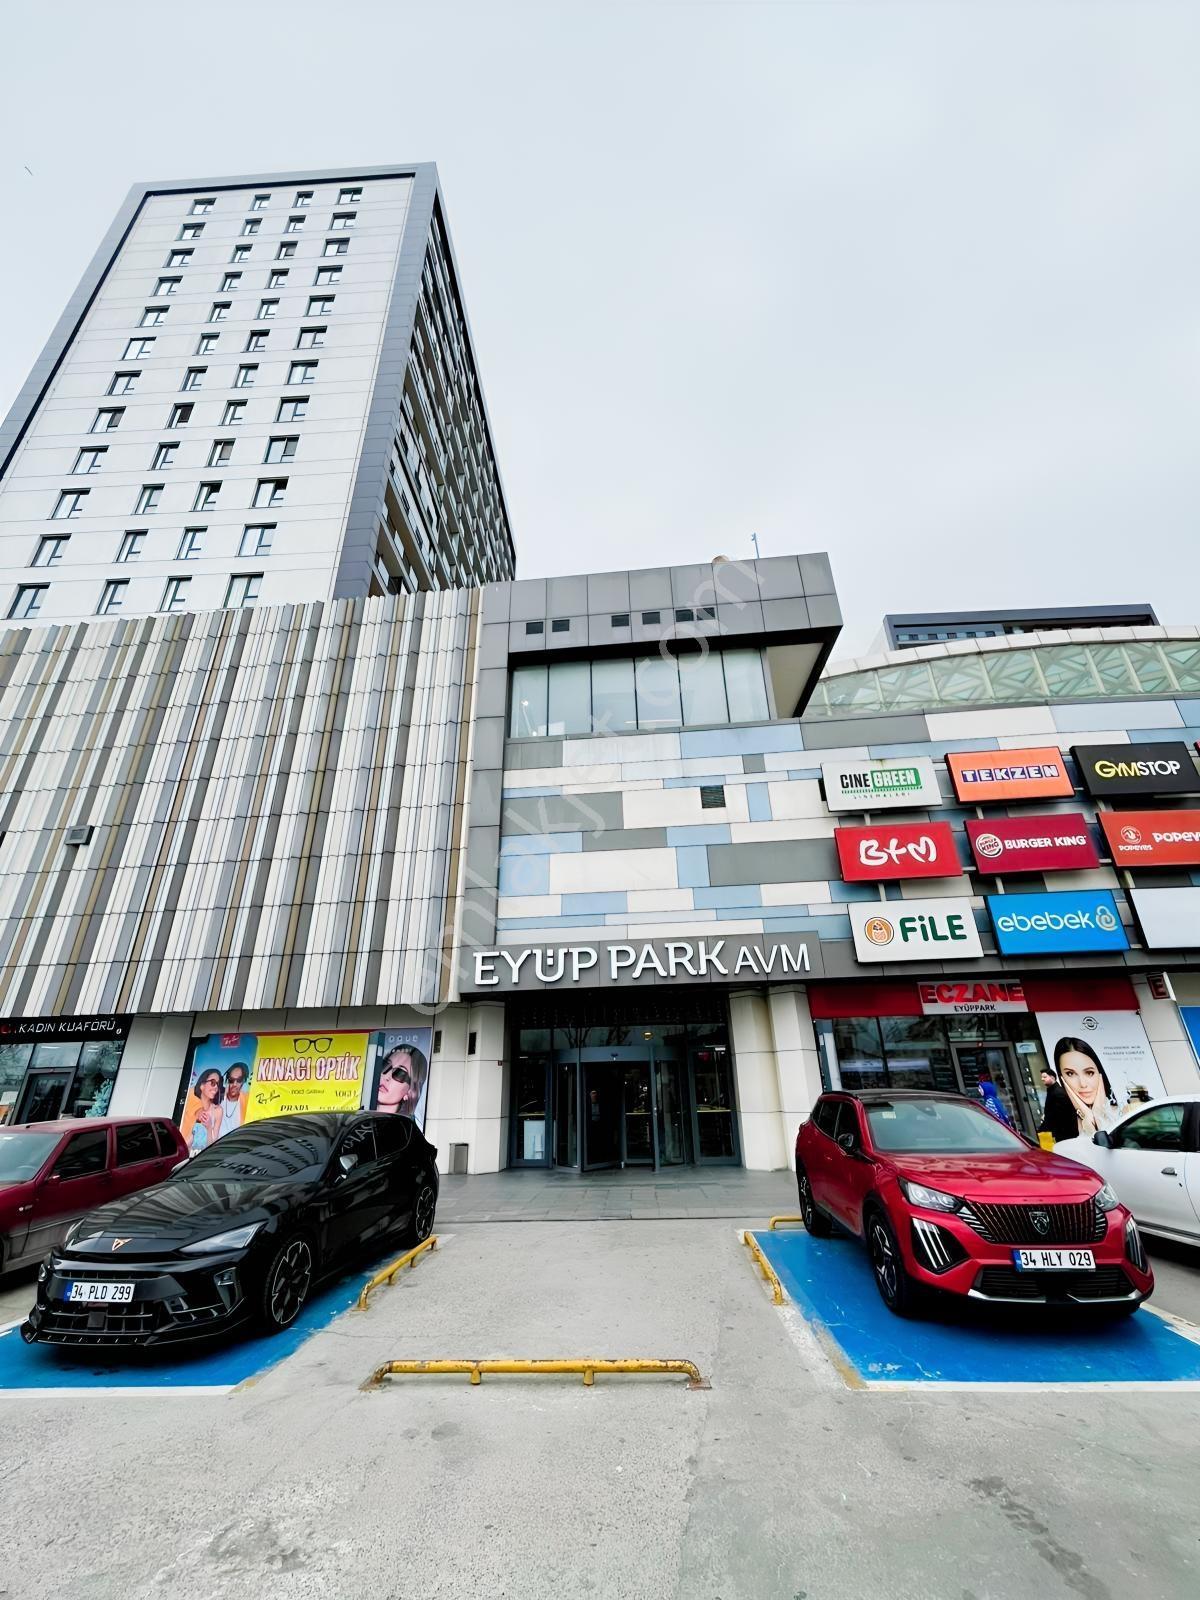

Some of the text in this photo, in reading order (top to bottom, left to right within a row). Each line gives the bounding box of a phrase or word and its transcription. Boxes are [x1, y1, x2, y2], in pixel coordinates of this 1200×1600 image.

[962, 765, 1059, 782] TEKZEN
[1095, 760, 1180, 778] GYMSTOP
[840, 770, 917, 789] CINE GREEN
[1004, 836, 1086, 850] BURGER KING
[998, 911, 1094, 932] ebebek
[473, 940, 811, 985] EYÜP PARK AVM
[920, 983, 1025, 1004] ECZANE
[954, 1003, 996, 1012] EYÜPPARK
[18, 1022, 56, 1033] KADIN
[58, 1018, 116, 1032] KUAFÖRÜ
[257, 1052, 361, 1081] KINACI OPTİK
[280, 1104, 310, 1112] PRADA
[1021, 1252, 1092, 1266] 34 HLY 029
[72, 1284, 83, 1299] 34
[112, 1286, 131, 1301] 299
